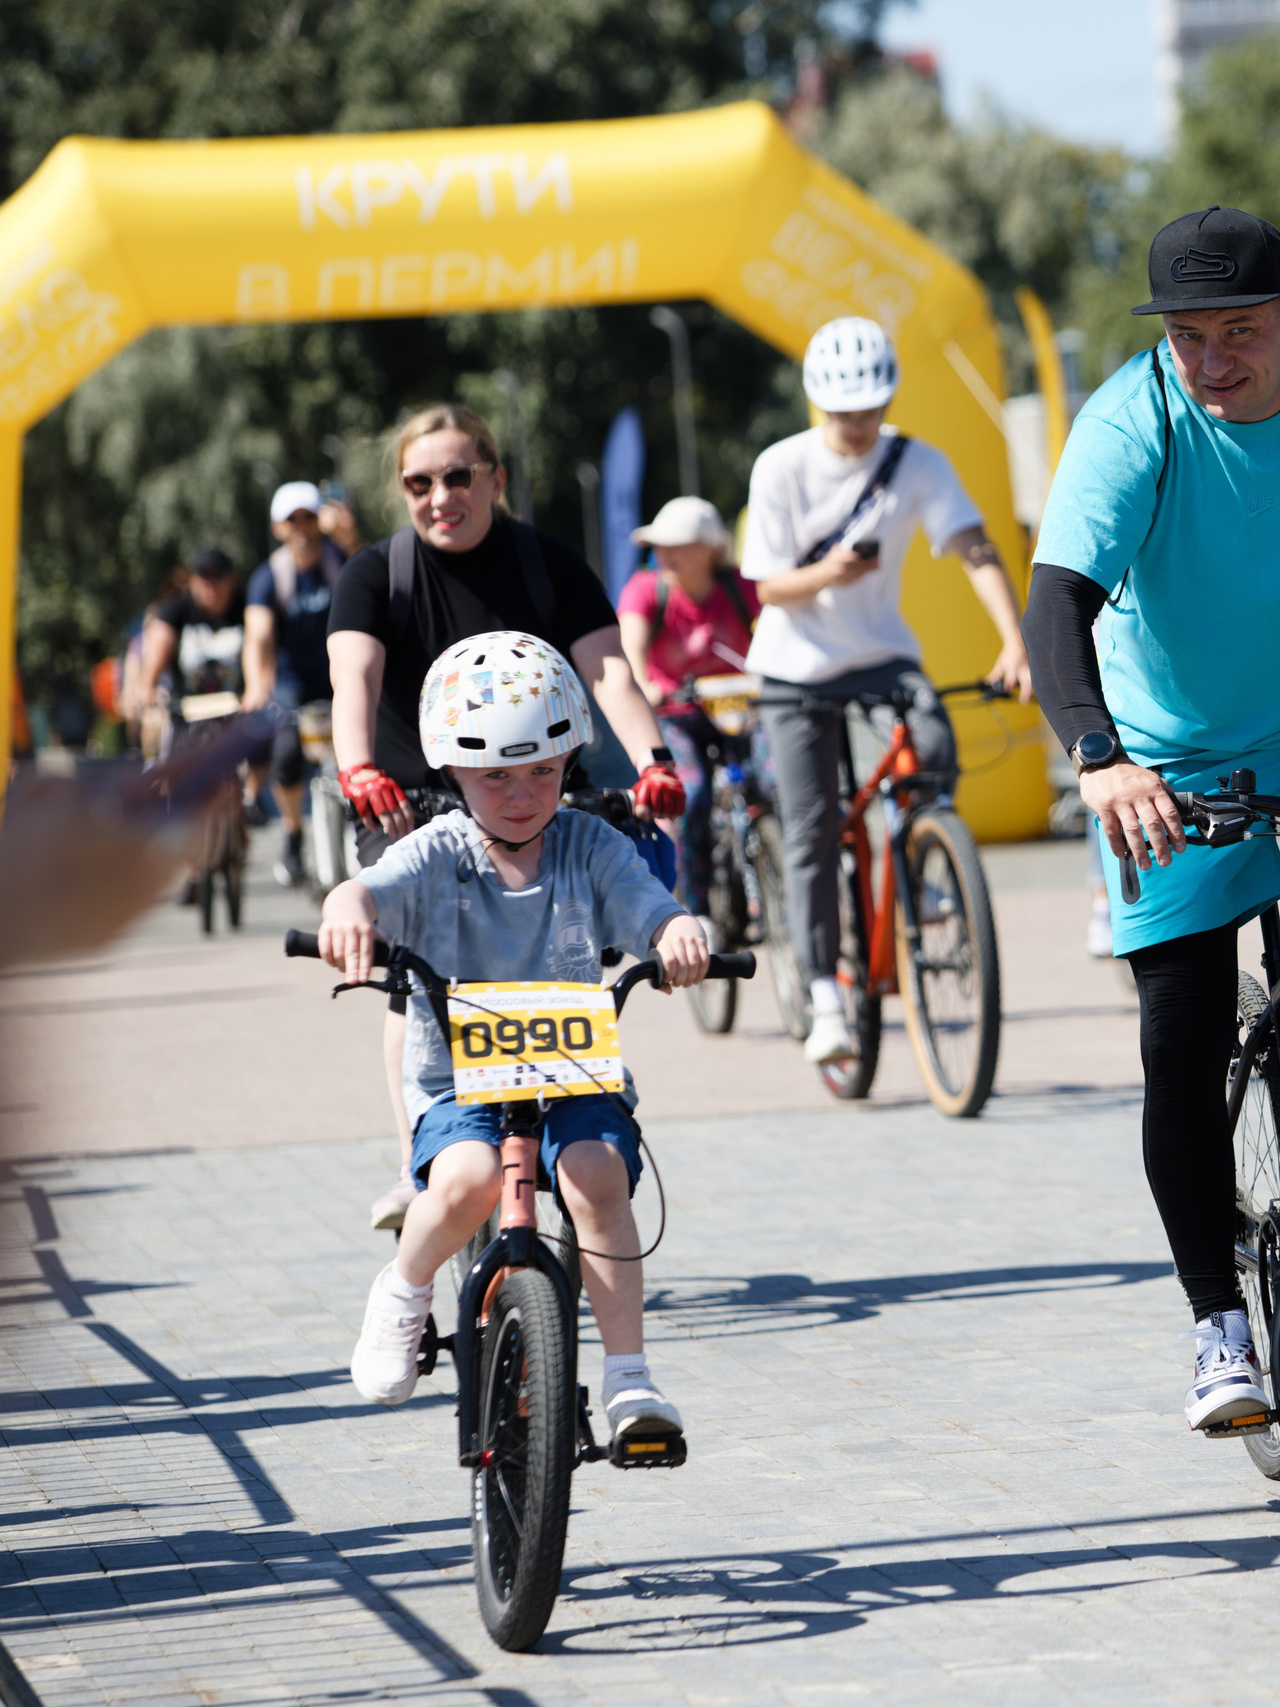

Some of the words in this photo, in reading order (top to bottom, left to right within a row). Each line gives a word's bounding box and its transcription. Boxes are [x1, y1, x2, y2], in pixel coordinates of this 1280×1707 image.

[295, 150, 574, 230] КРУТИ
[235, 262, 290, 312] В
[316, 237, 640, 312] ПЕРМИ!
[1250, 497, 1273, 511] NIKE
[461, 1017, 593, 1058] 0990
